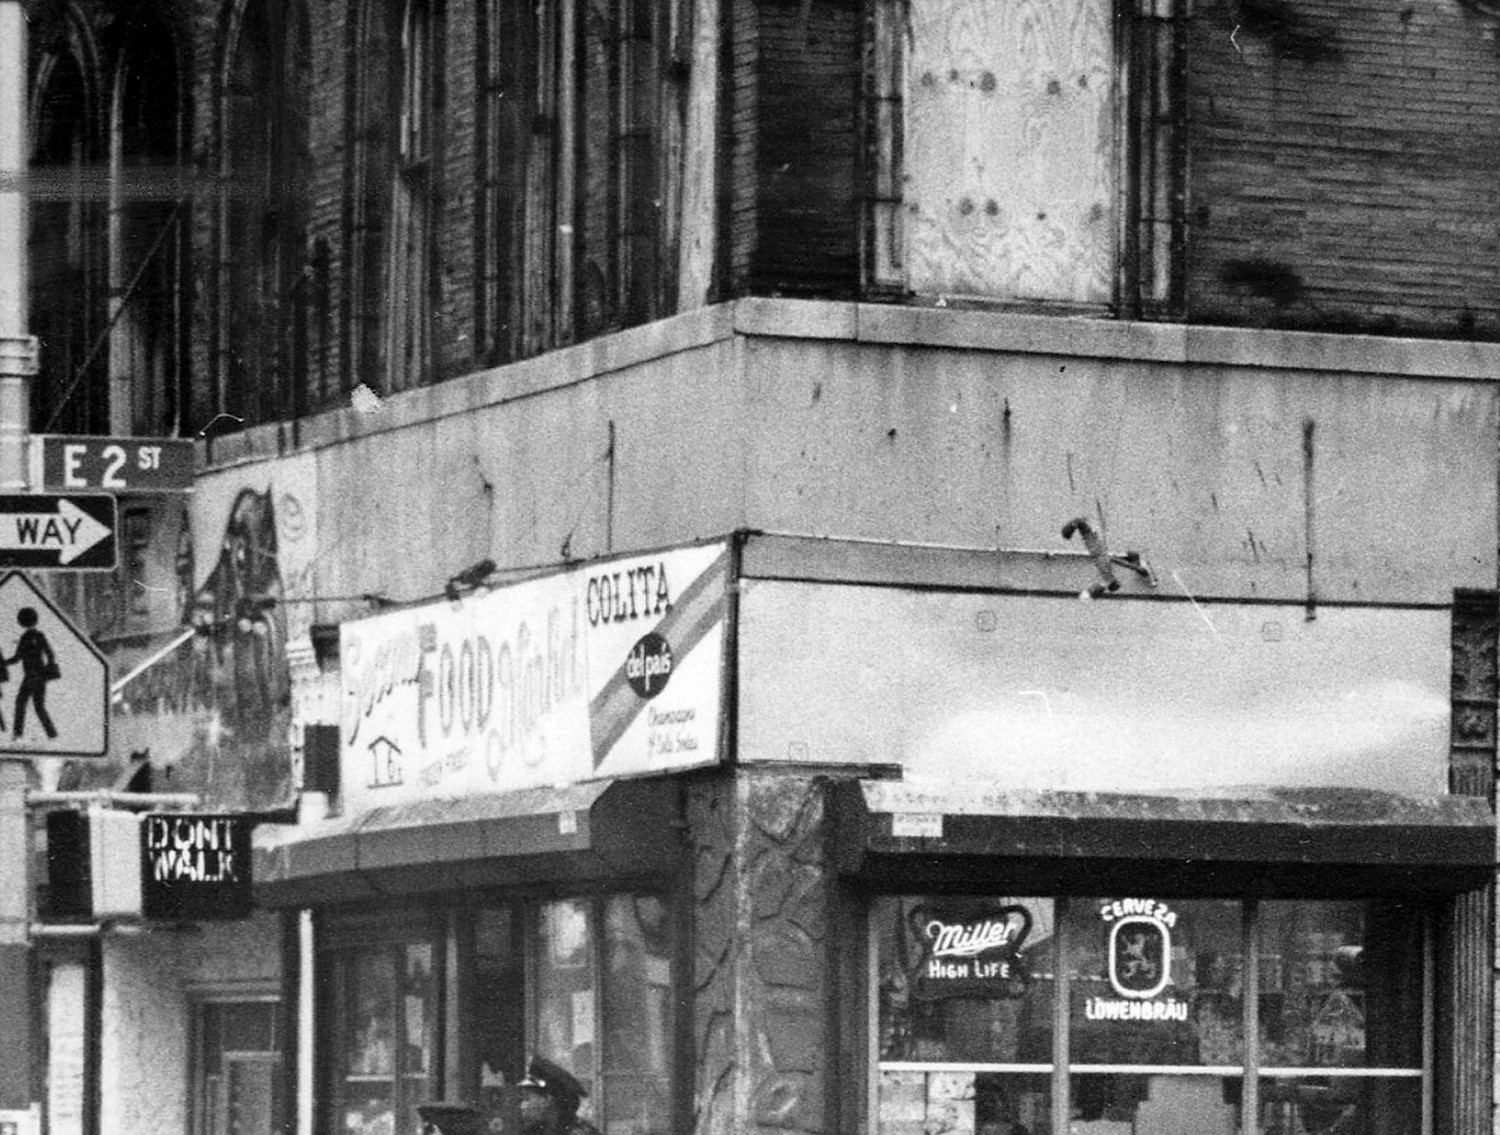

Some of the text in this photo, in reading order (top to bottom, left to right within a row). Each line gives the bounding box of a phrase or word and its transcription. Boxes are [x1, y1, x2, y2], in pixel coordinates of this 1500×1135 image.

[63, 444, 162, 489] E 2 ST
[16, 516, 83, 545] WAY
[587, 562, 673, 627] COLITA
[417, 623, 494, 749] FOOD
[148, 850, 239, 882] WALK
[1100, 898, 1177, 928] CERVEZA
[926, 920, 1018, 956] Miller
[1085, 997, 1188, 1021] LÖWENBRÄU
